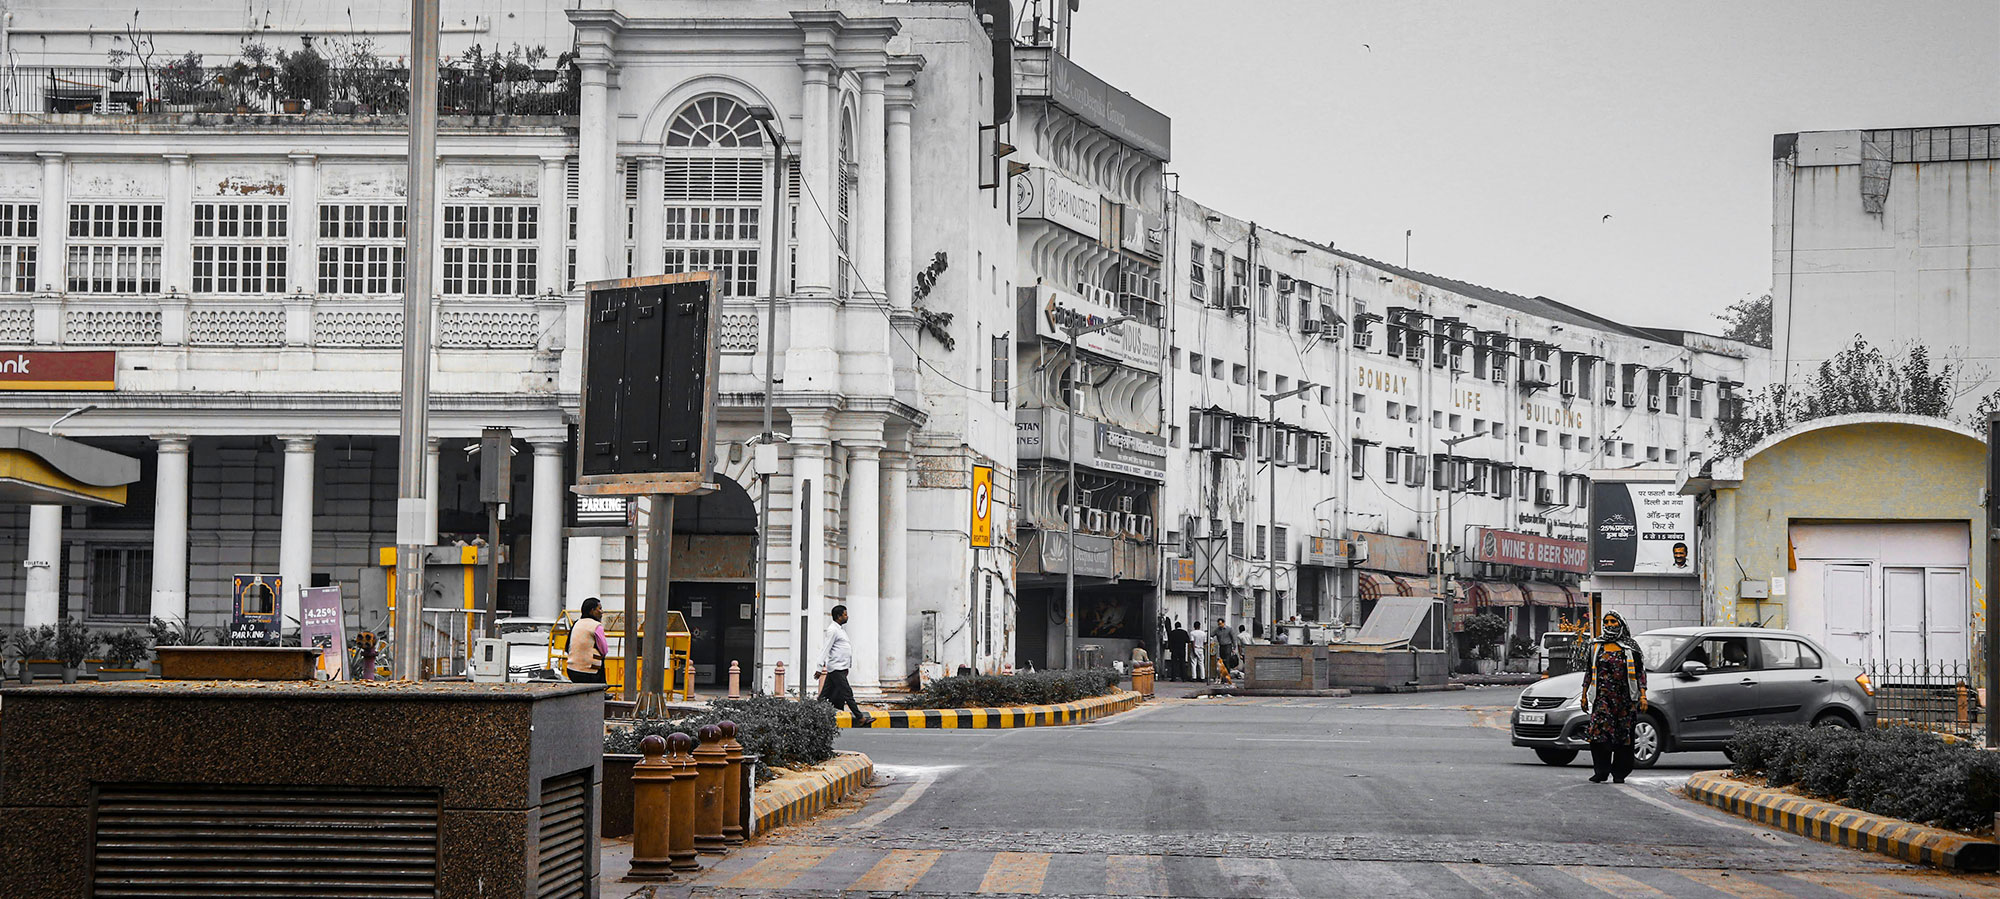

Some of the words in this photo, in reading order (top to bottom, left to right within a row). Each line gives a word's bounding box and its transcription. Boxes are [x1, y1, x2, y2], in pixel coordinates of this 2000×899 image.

[0, 354, 30, 374] nk
[1359, 366, 1407, 396] BOMBAY
[1454, 388, 1481, 411] LIFE
[1526, 402, 1582, 429] BUILDING
[581, 498, 622, 511] PARKING
[1644, 498, 1660, 506] दिल्ली
[1646, 510, 1681, 520] ऑड-इवन
[1652, 521, 1666, 530] फिर
[1667, 521, 1675, 530] से
[1501, 539, 1526, 560] WINE
[1528, 543, 1535, 560] &
[1537, 544, 1561, 563] BEER
[1563, 547, 1586, 566] SHOP
[307, 607, 336, 618] 4.25%
[231, 631, 264, 639] PARKING
